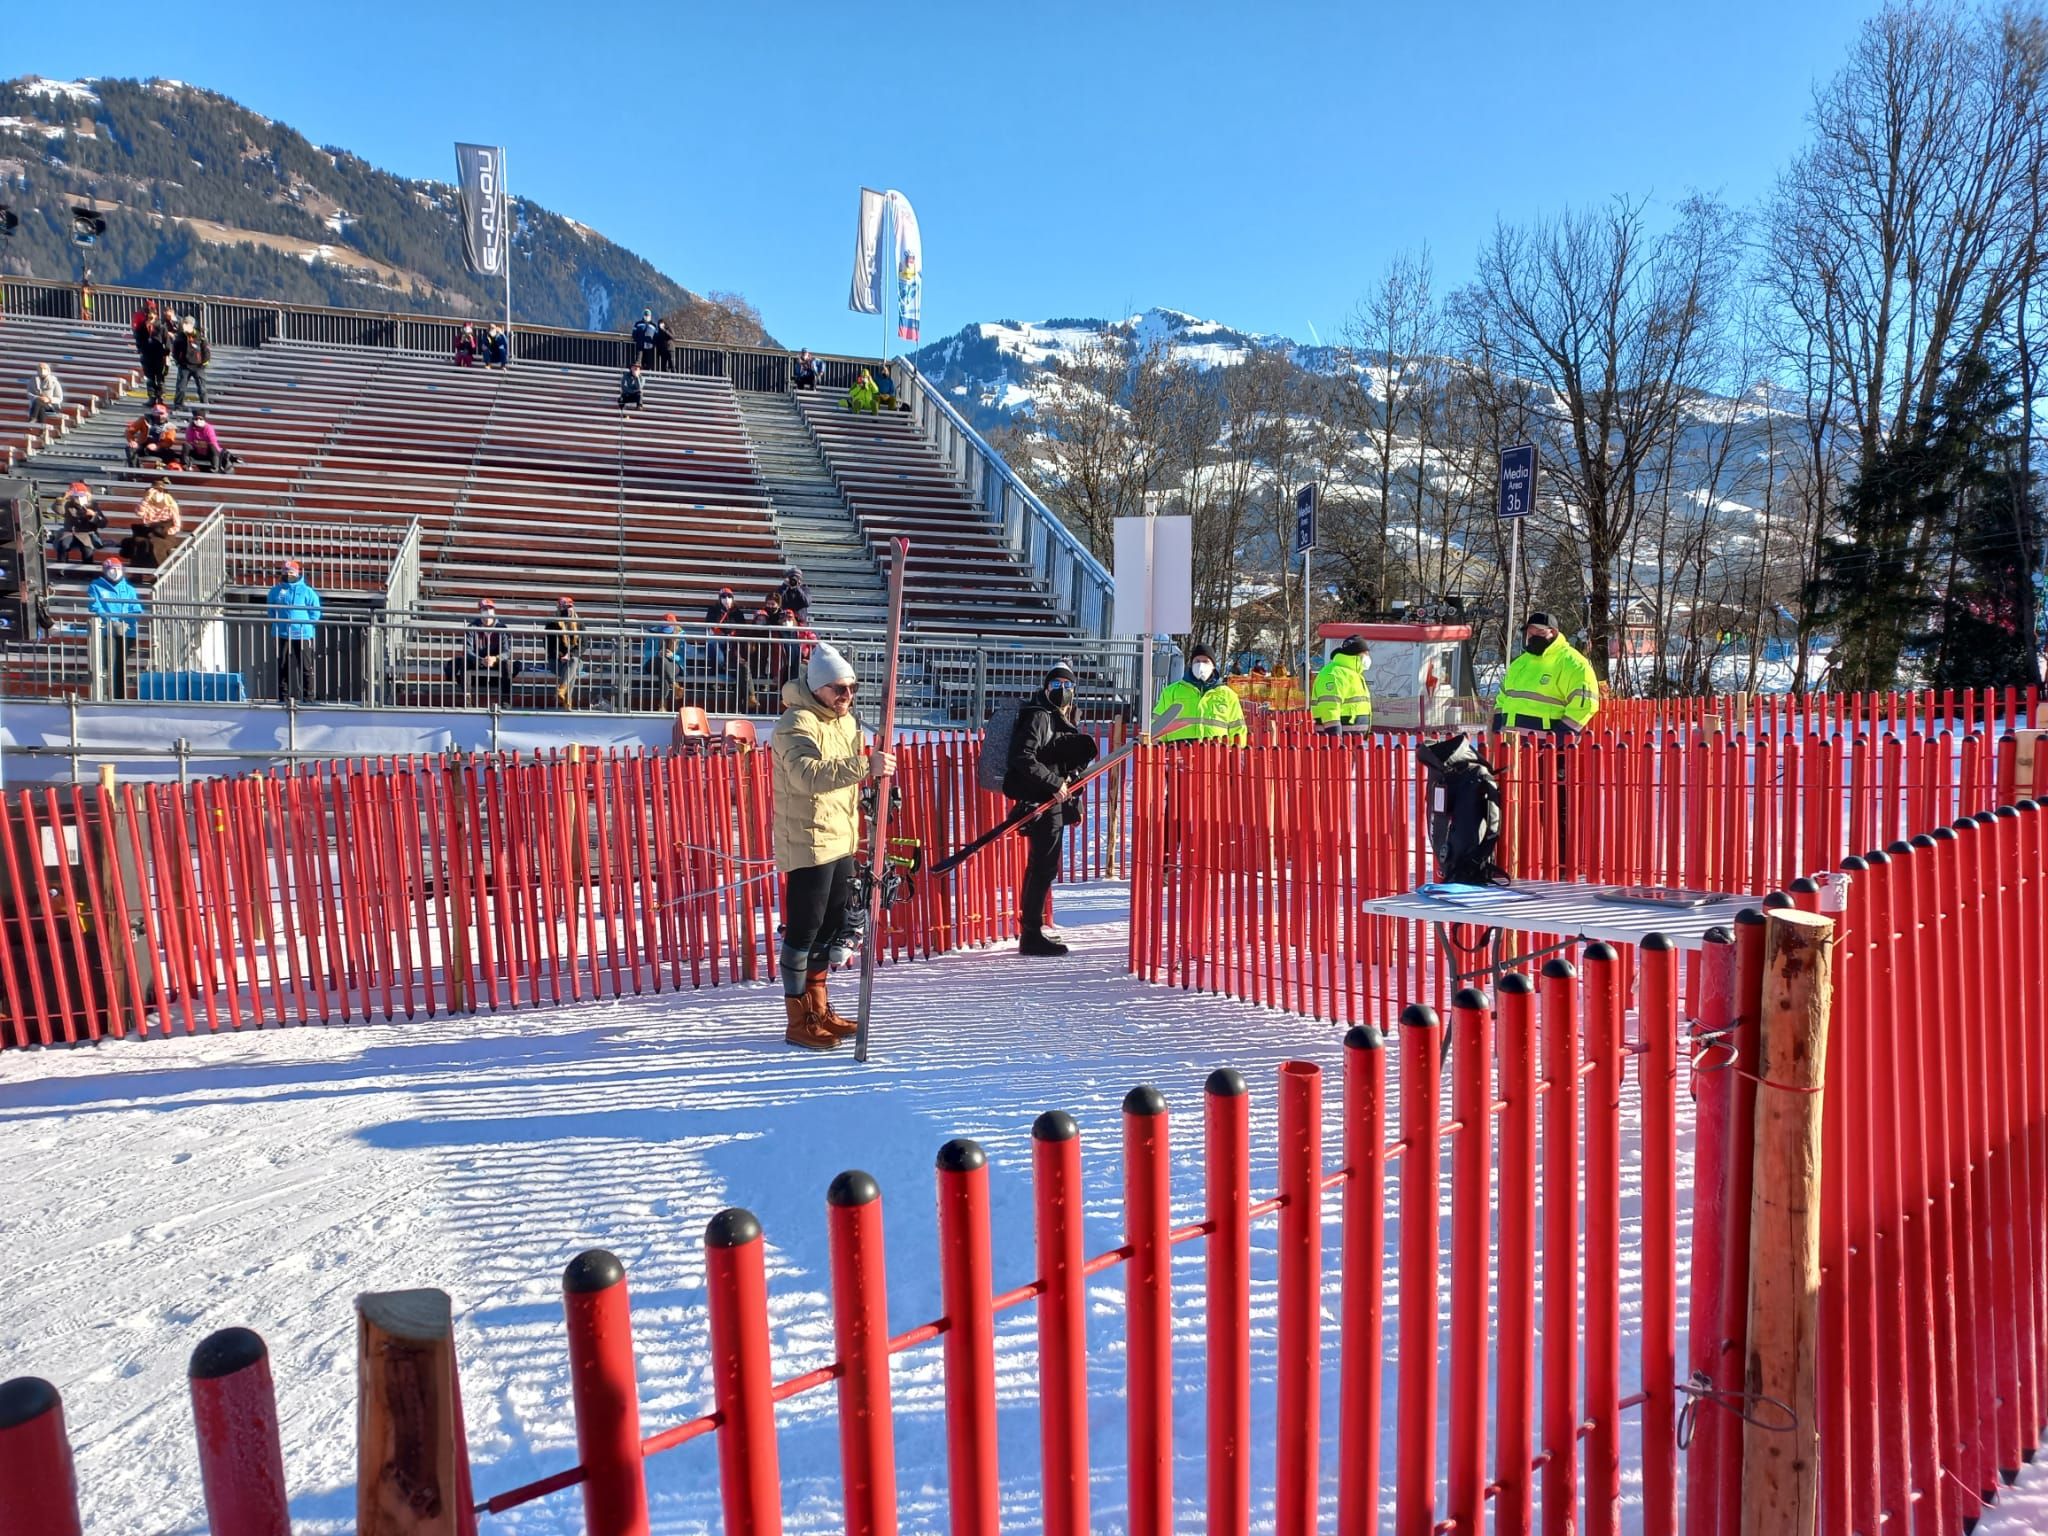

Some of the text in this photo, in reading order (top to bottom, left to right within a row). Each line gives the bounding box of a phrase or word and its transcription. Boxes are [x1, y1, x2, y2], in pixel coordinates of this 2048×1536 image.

[1503, 464, 1529, 480] Media
[1508, 481, 1523, 490] Area
[1507, 493, 1521, 511] 3b
